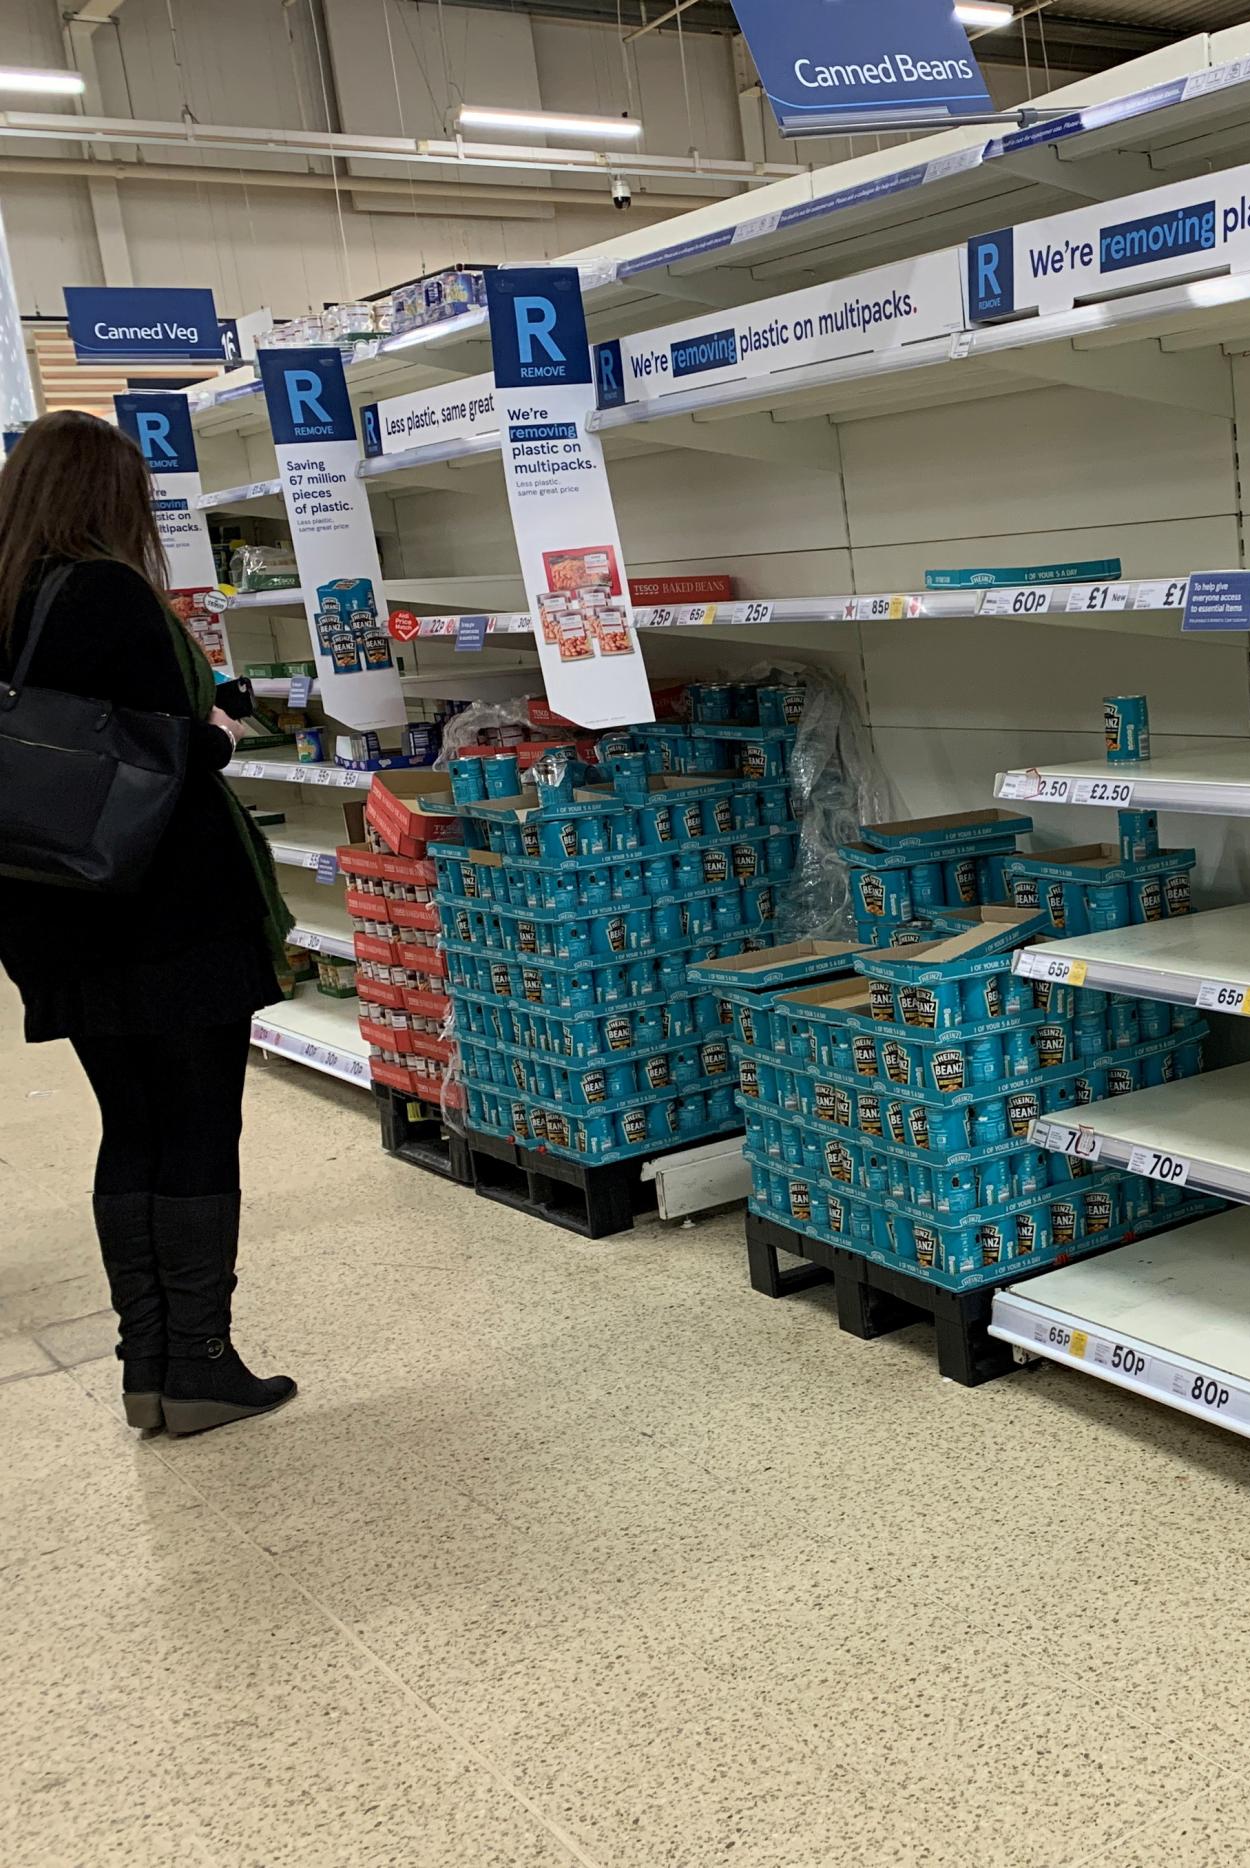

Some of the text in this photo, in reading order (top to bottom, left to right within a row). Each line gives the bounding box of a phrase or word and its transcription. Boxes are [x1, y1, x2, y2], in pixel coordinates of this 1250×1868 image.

[794, 54, 972, 87] Canned Beans
[1029, 238, 1094, 278] We're
[1100, 209, 1214, 264] removing
[978, 243, 1001, 298] R
[979, 298, 1001, 311] REMOVE
[94, 322, 198, 343] Canned Veg
[513, 296, 567, 364] R
[631, 289, 918, 378] We're removing plastic on multipacks.
[520, 365, 566, 378] REMOVE
[600, 349, 617, 391] R
[284, 369, 333, 424] R
[385, 393, 495, 436] Less plastic, same great
[507, 407, 548, 421] We're
[136, 412, 178, 458] R
[295, 426, 334, 436] REMOVE
[365, 411, 377, 445] R
[510, 423, 577, 441] removing
[512, 443, 582, 459] plastic on
[287, 460, 326, 472] Saving
[514, 458, 597, 475] multipacks.
[289, 473, 346, 486] 67 million
[292, 489, 332, 502] pieces
[517, 486, 580, 497] same great price
[295, 501, 354, 516] of plastic.
[634, 579, 724, 594] TESCO BAKED BEANS
[1163, 583, 1188, 607] £1
[1194, 582, 1229, 593] To help give
[1012, 591, 1046, 614] 60p
[1087, 587, 1126, 609] £1 New
[1192, 594, 1242, 603] everyone access
[689, 608, 705, 621] 65p
[745, 604, 768, 622] 25p
[872, 600, 890, 615] 85p
[1190, 604, 1243, 613] to essential items
[650, 609, 671, 626] 25p
[1039, 781, 1068, 797] 2.50
[1090, 783, 1130, 801] £2.50
[1048, 961, 1070, 978] 65p
[1217, 988, 1243, 1007] 65p
[937, 1052, 960, 1063] HEINZ
[935, 1062, 963, 1075] BEANZ
[1152, 1153, 1184, 1181] 70p
[1048, 1326, 1071, 1347] 65p
[1110, 1344, 1145, 1377] 50p
[1190, 1376, 1230, 1409] 80p
